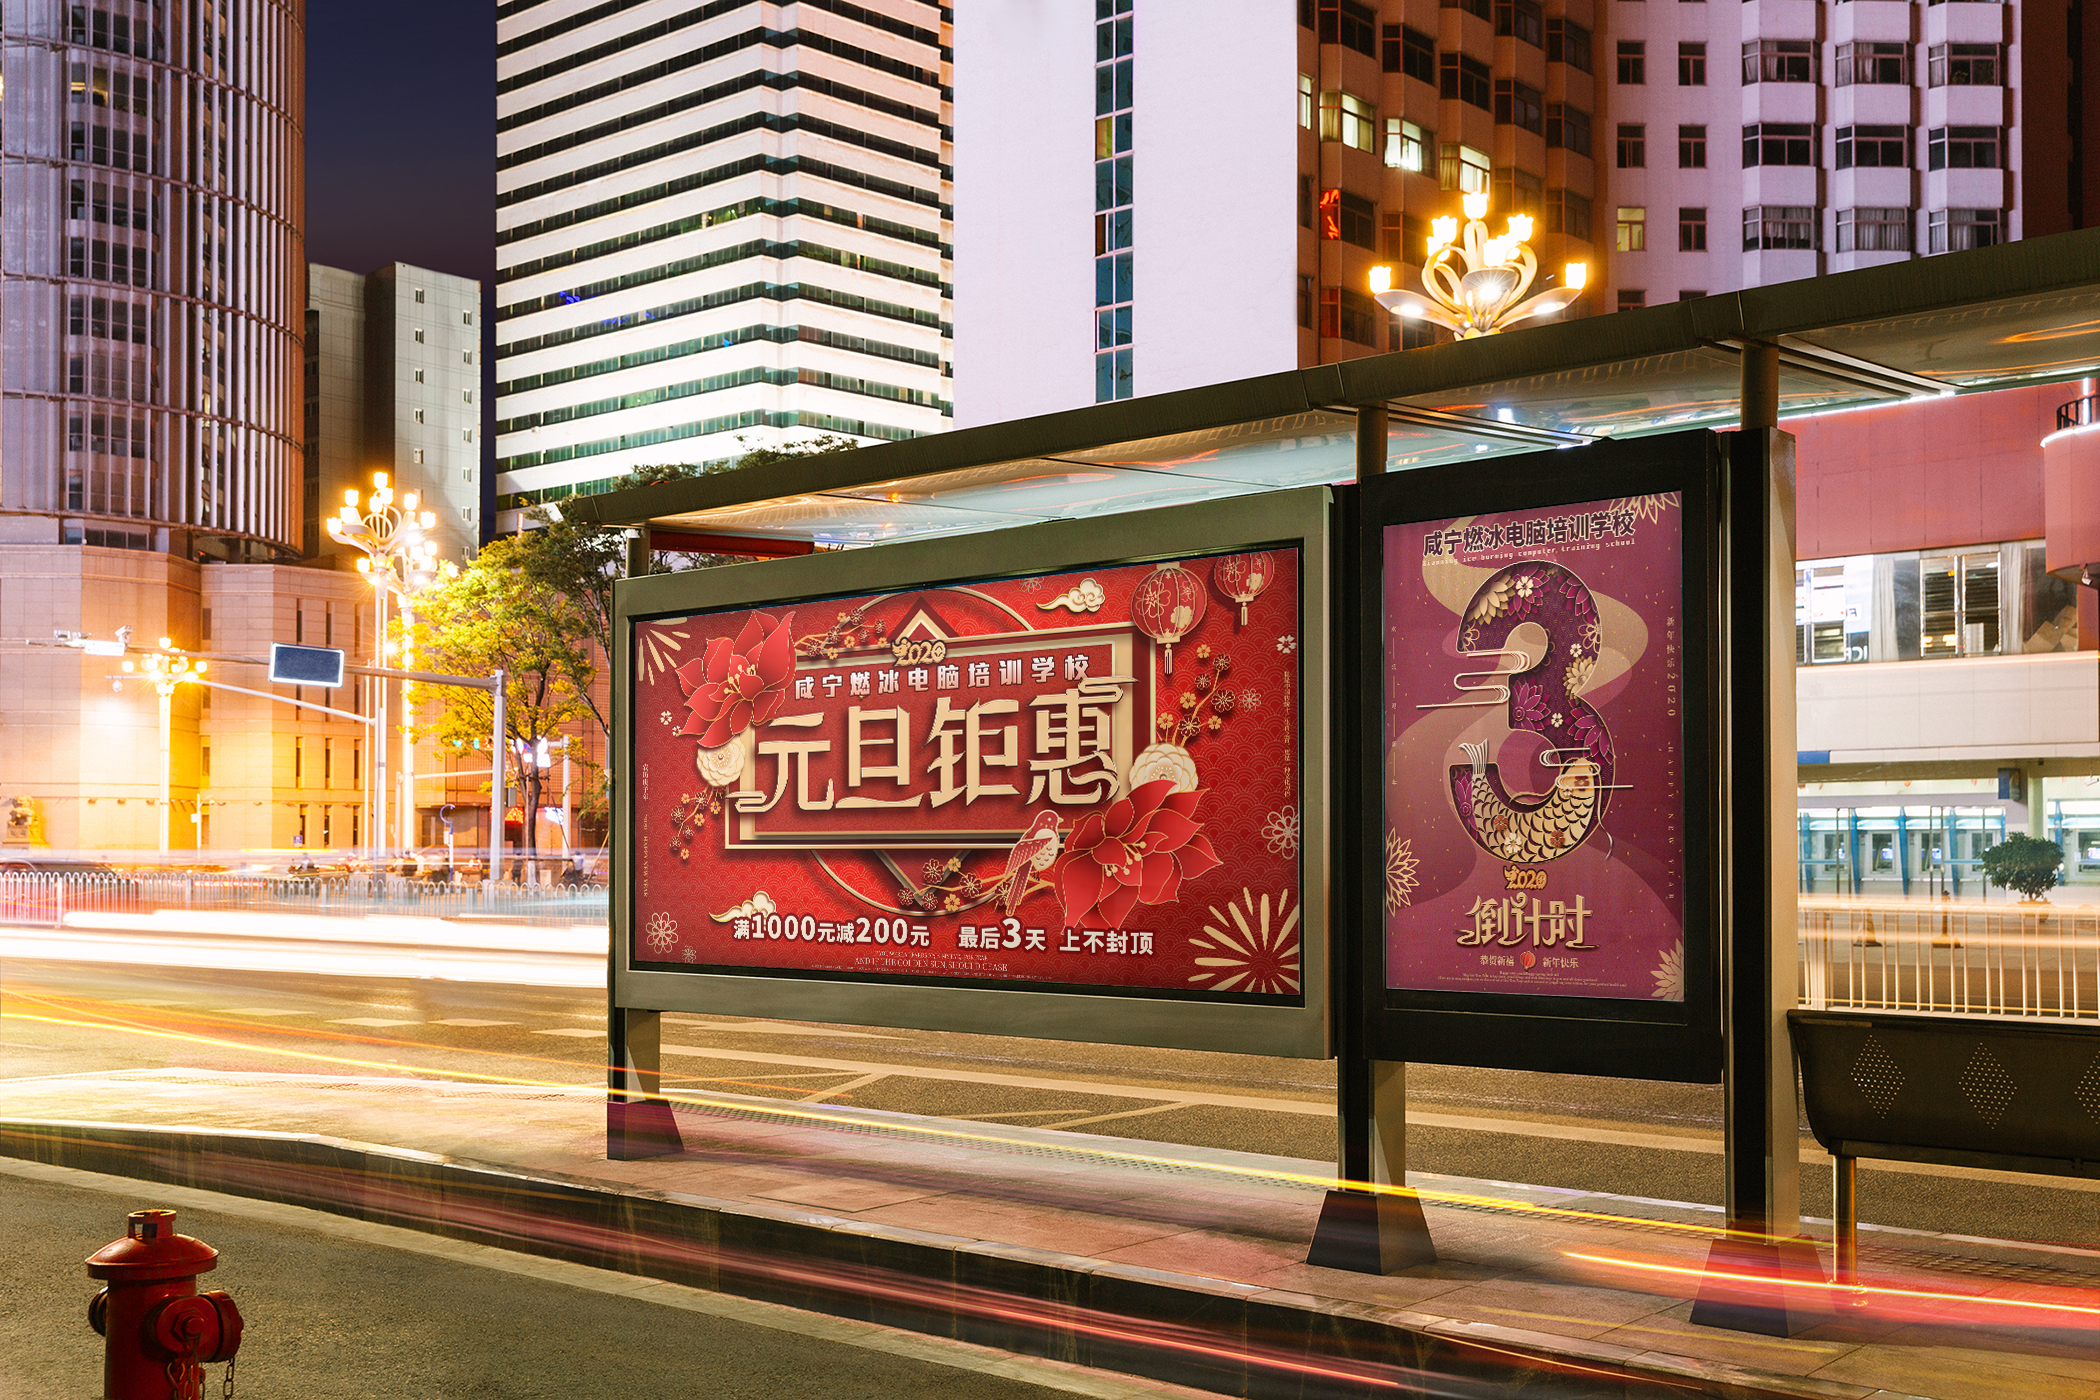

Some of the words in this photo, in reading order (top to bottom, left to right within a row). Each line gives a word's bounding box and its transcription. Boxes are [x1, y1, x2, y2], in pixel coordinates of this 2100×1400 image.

[1423, 509, 1635, 557] 咸宁燃冰电脑培训学校
[892, 637, 947, 667] 2020
[794, 653, 1090, 700] 咸宁燃冰电脑培训学校
[728, 676, 1138, 814] 元旦钜惠
[1503, 865, 1548, 890] 2020
[733, 914, 931, 948] 满1000元减200元
[957, 918, 1048, 951] 最后3天
[1059, 927, 1154, 956] 上不封顶
[1454, 892, 1600, 949] 倒计时
[1542, 957, 1579, 969] 新年快乐
